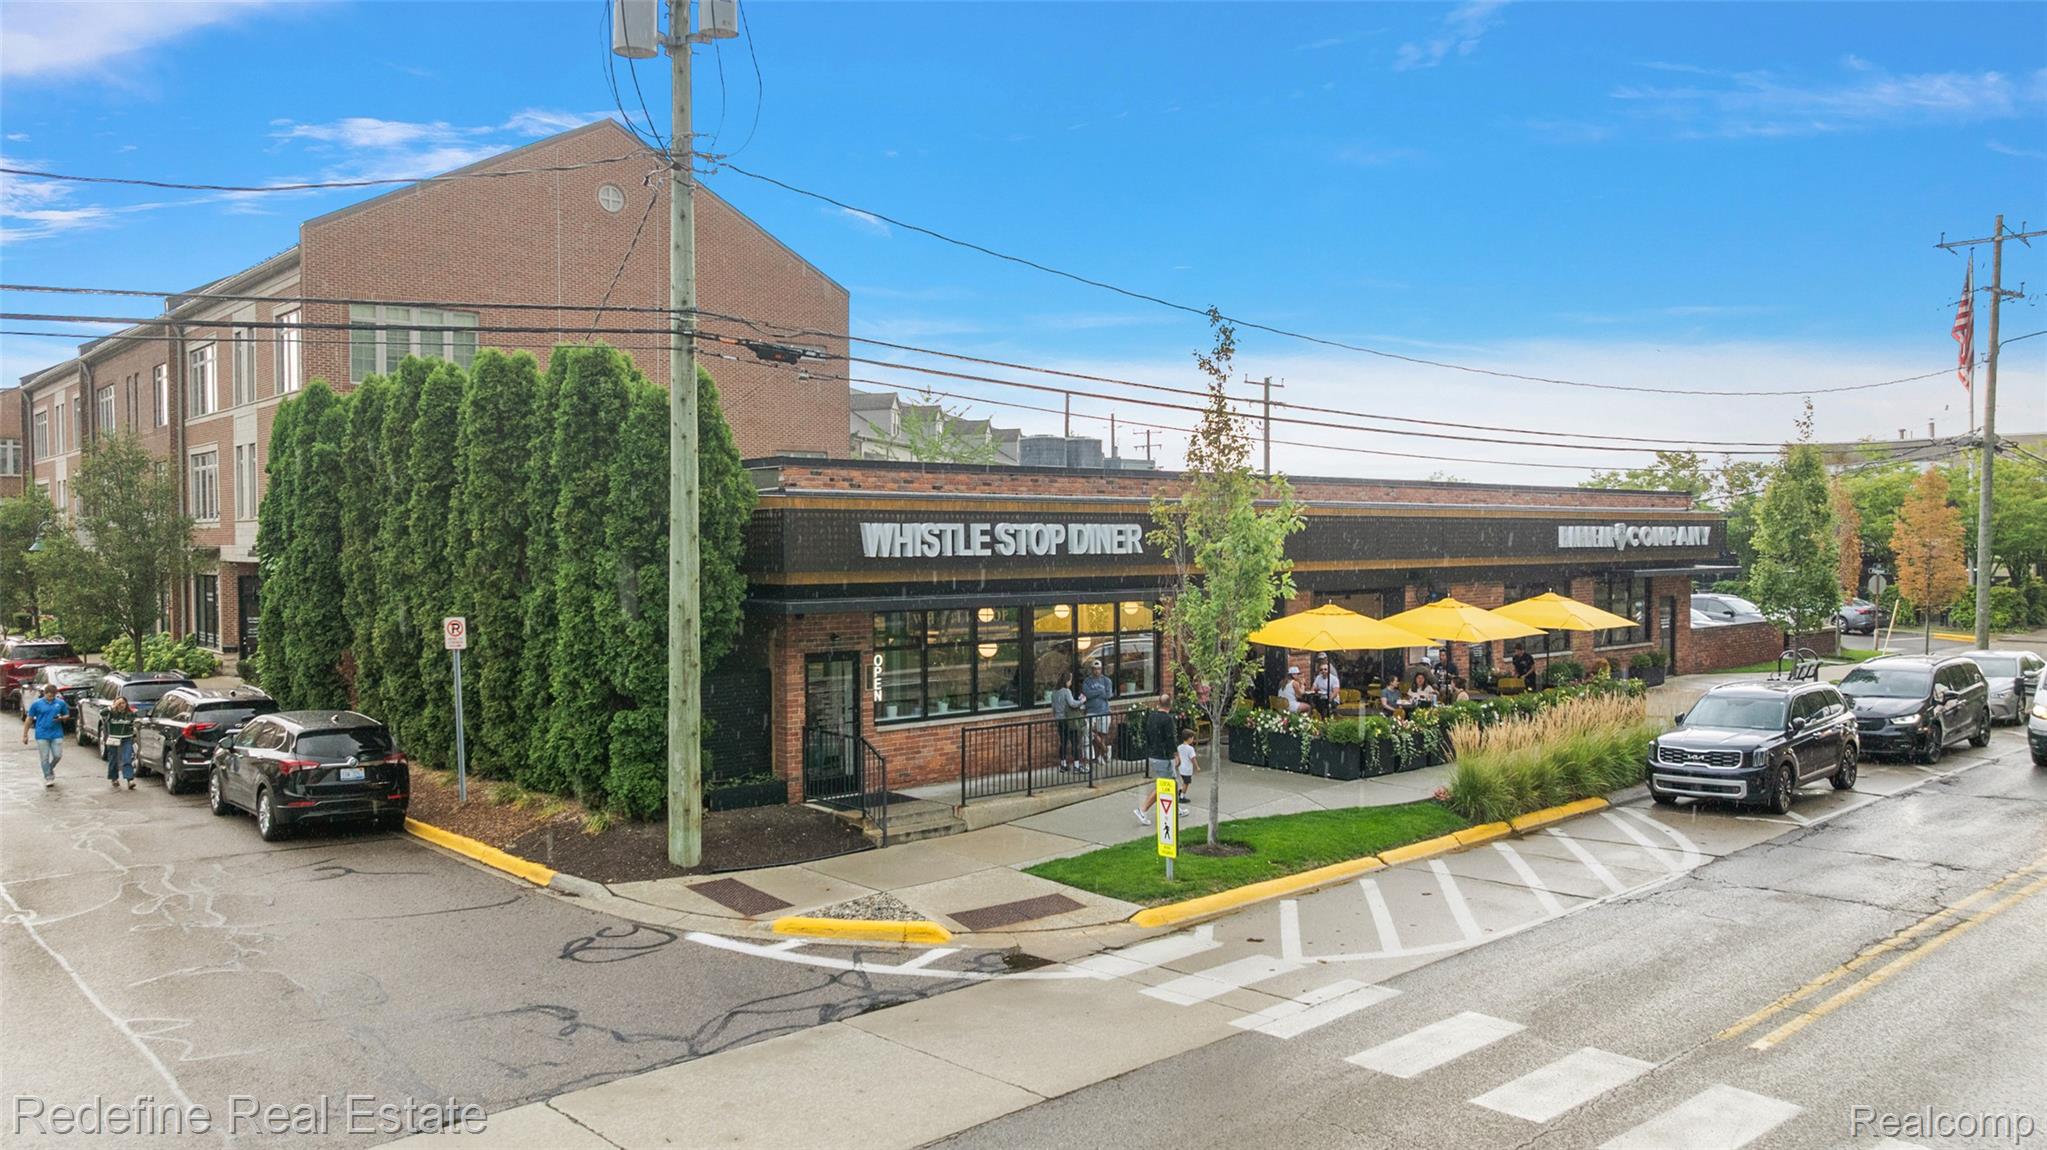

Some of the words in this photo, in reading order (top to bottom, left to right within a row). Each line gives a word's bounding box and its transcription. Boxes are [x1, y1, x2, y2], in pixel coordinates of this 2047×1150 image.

[859, 522, 992, 558] WHISTLE
[994, 522, 1066, 557] STOP
[1068, 523, 1144, 555] DINER
[1626, 526, 1711, 547] COMPANY
[873, 654, 884, 702] OPEN
